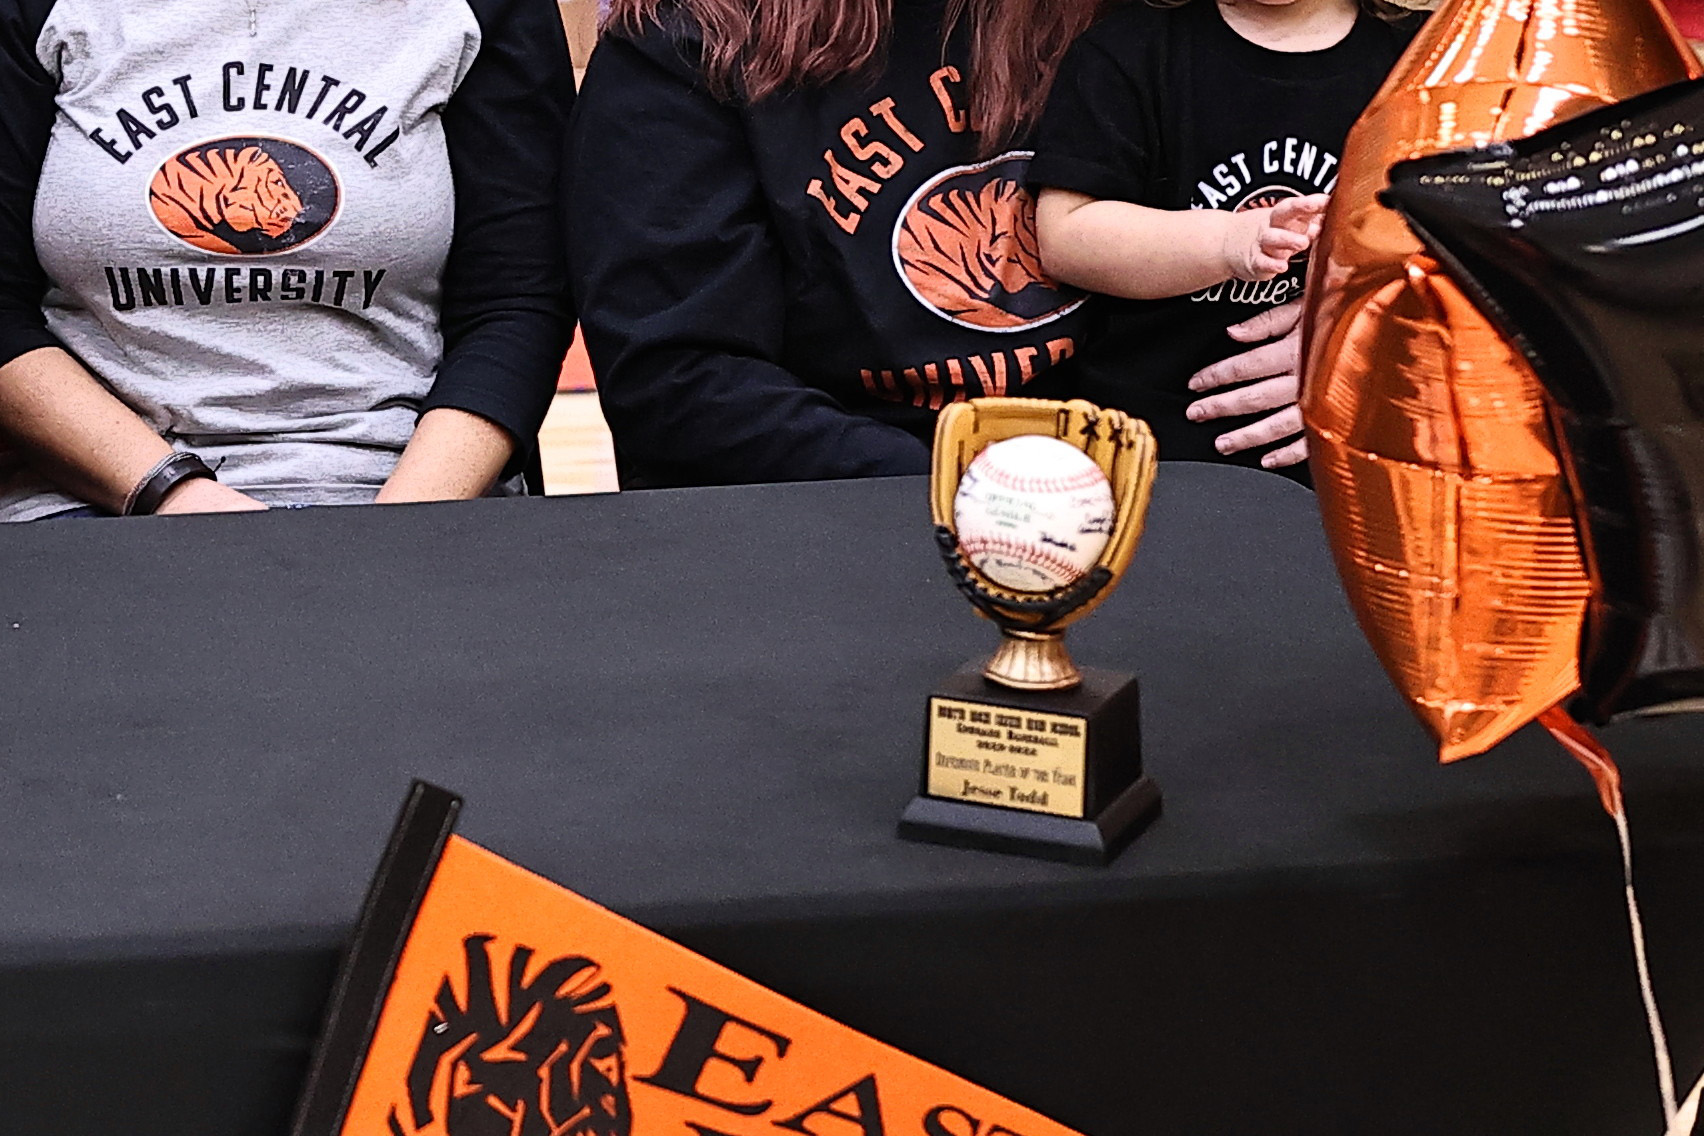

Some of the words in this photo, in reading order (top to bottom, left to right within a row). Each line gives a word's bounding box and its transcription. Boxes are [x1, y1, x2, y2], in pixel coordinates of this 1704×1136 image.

[89, 74, 199, 165] EAST
[222, 61, 401, 169] CENTRAL
[806, 96, 925, 235] EAST
[104, 266, 387, 312] UNIVERSITY
